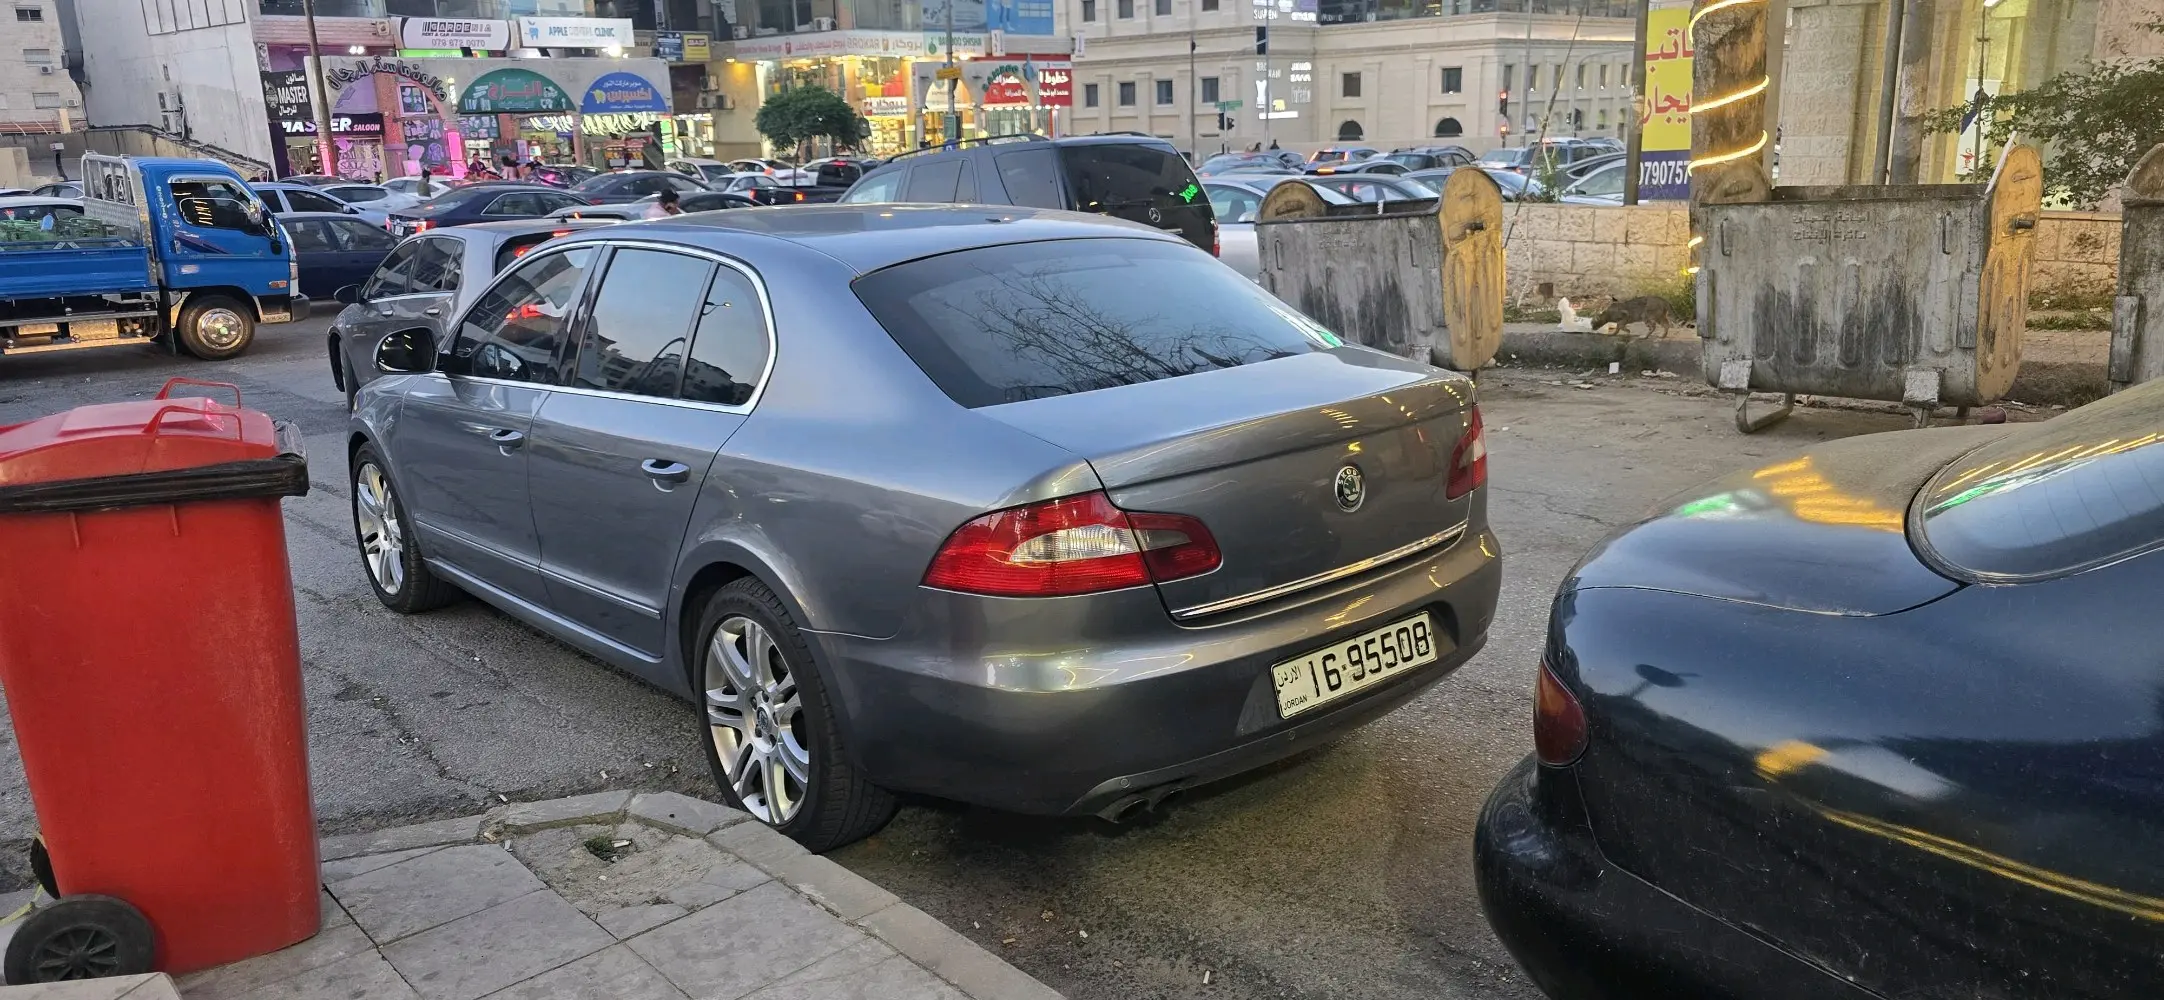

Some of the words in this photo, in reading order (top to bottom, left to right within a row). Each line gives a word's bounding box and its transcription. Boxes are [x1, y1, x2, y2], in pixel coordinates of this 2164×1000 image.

[549, 27, 568, 36] APPLE
[595, 28, 615, 37] CLINIC
[1646, 28, 1694, 73] اتب
[278, 86, 308, 104] MASTER
[1643, 85, 1690, 124] يجار
[282, 118, 352, 133] MASER
[353, 124, 381, 132] SALOON
[1283, 694, 1309, 711] JORDAN
